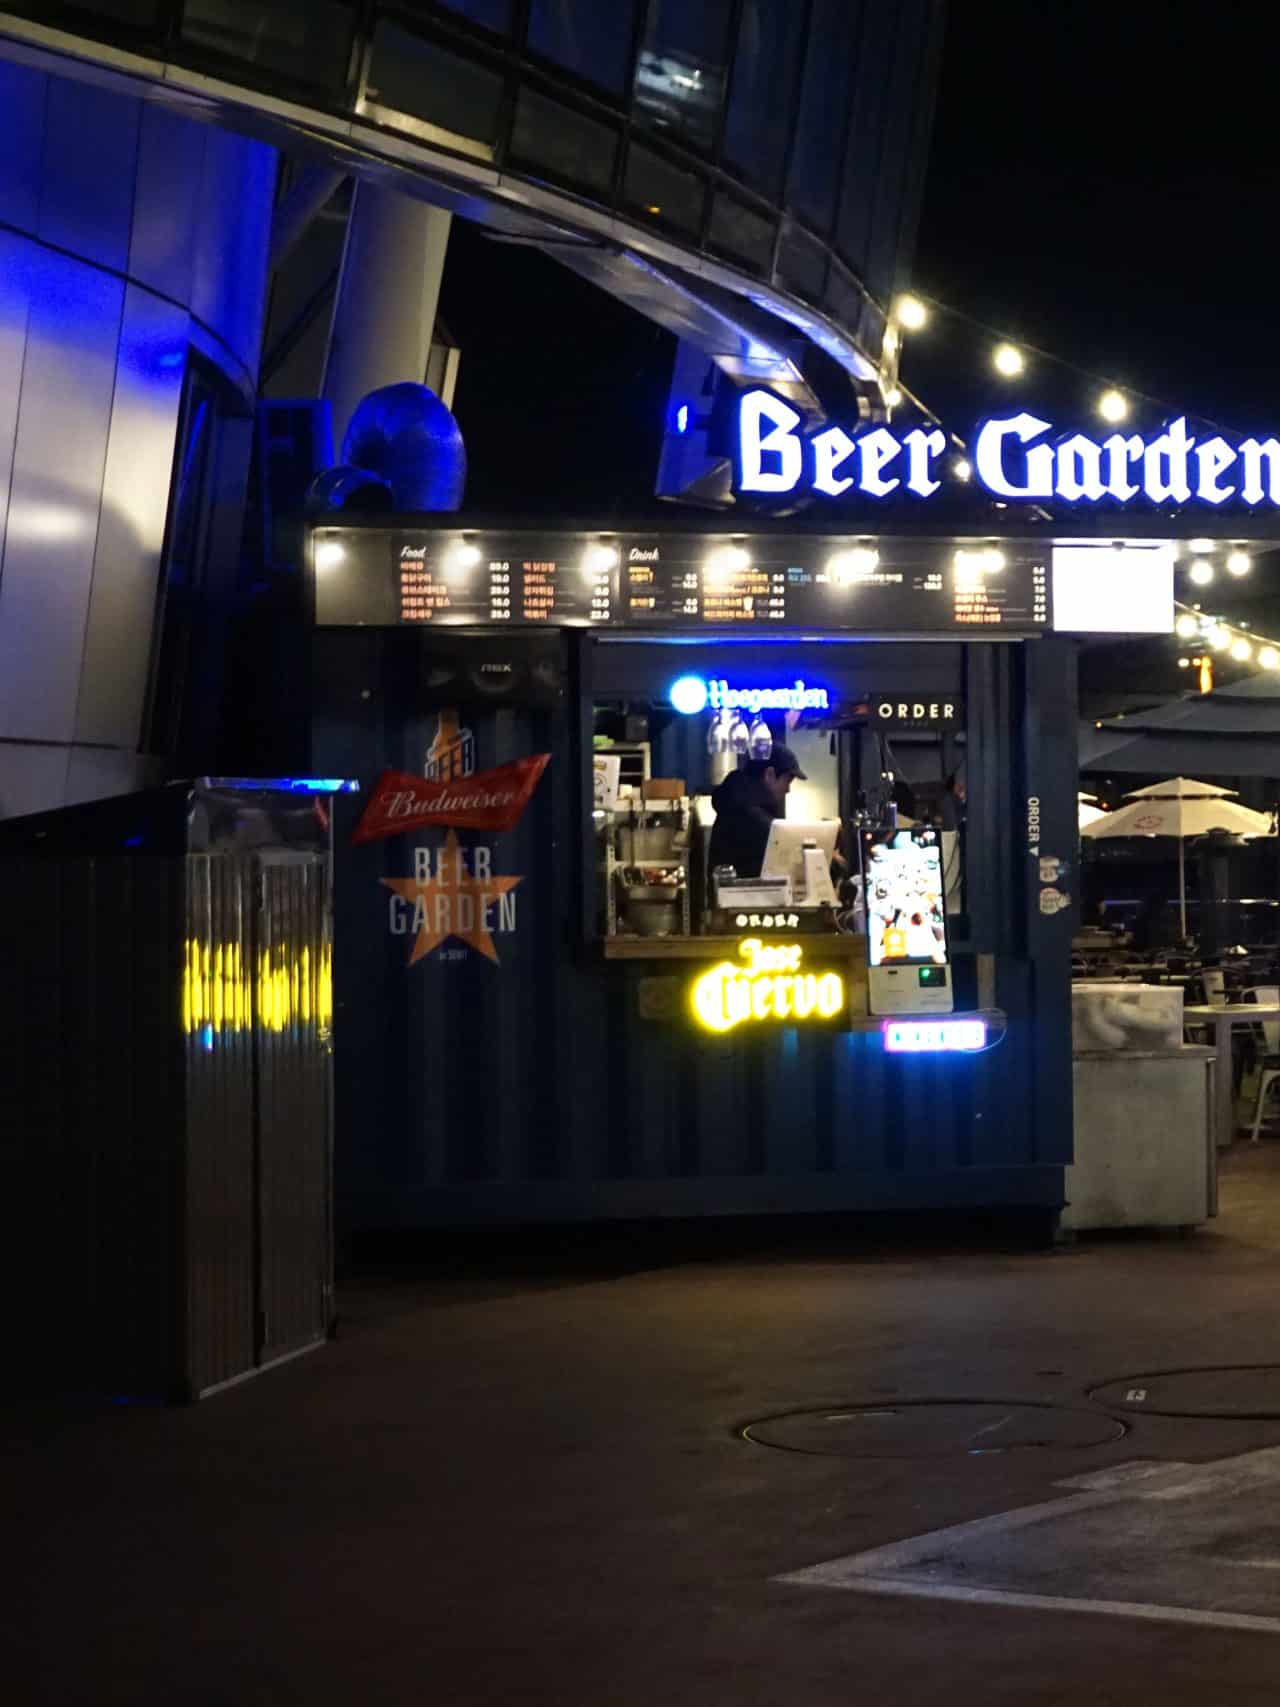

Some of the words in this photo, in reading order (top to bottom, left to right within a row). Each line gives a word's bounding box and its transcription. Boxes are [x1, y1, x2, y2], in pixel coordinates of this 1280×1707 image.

[739, 389, 947, 498] Beer
[400, 545, 427, 559] Food
[629, 547, 659, 561] Drink
[708, 679, 829, 713] Hoegaarden
[877, 702, 955, 719] ORDER
[380, 787, 516, 818] Budweiser
[1027, 796, 1040, 843] ORDER
[414, 847, 492, 887] BEER
[388, 892, 517, 935] GARDEN
[735, 913, 800, 928] ORDER
[692, 961, 846, 1033] Cuervo
